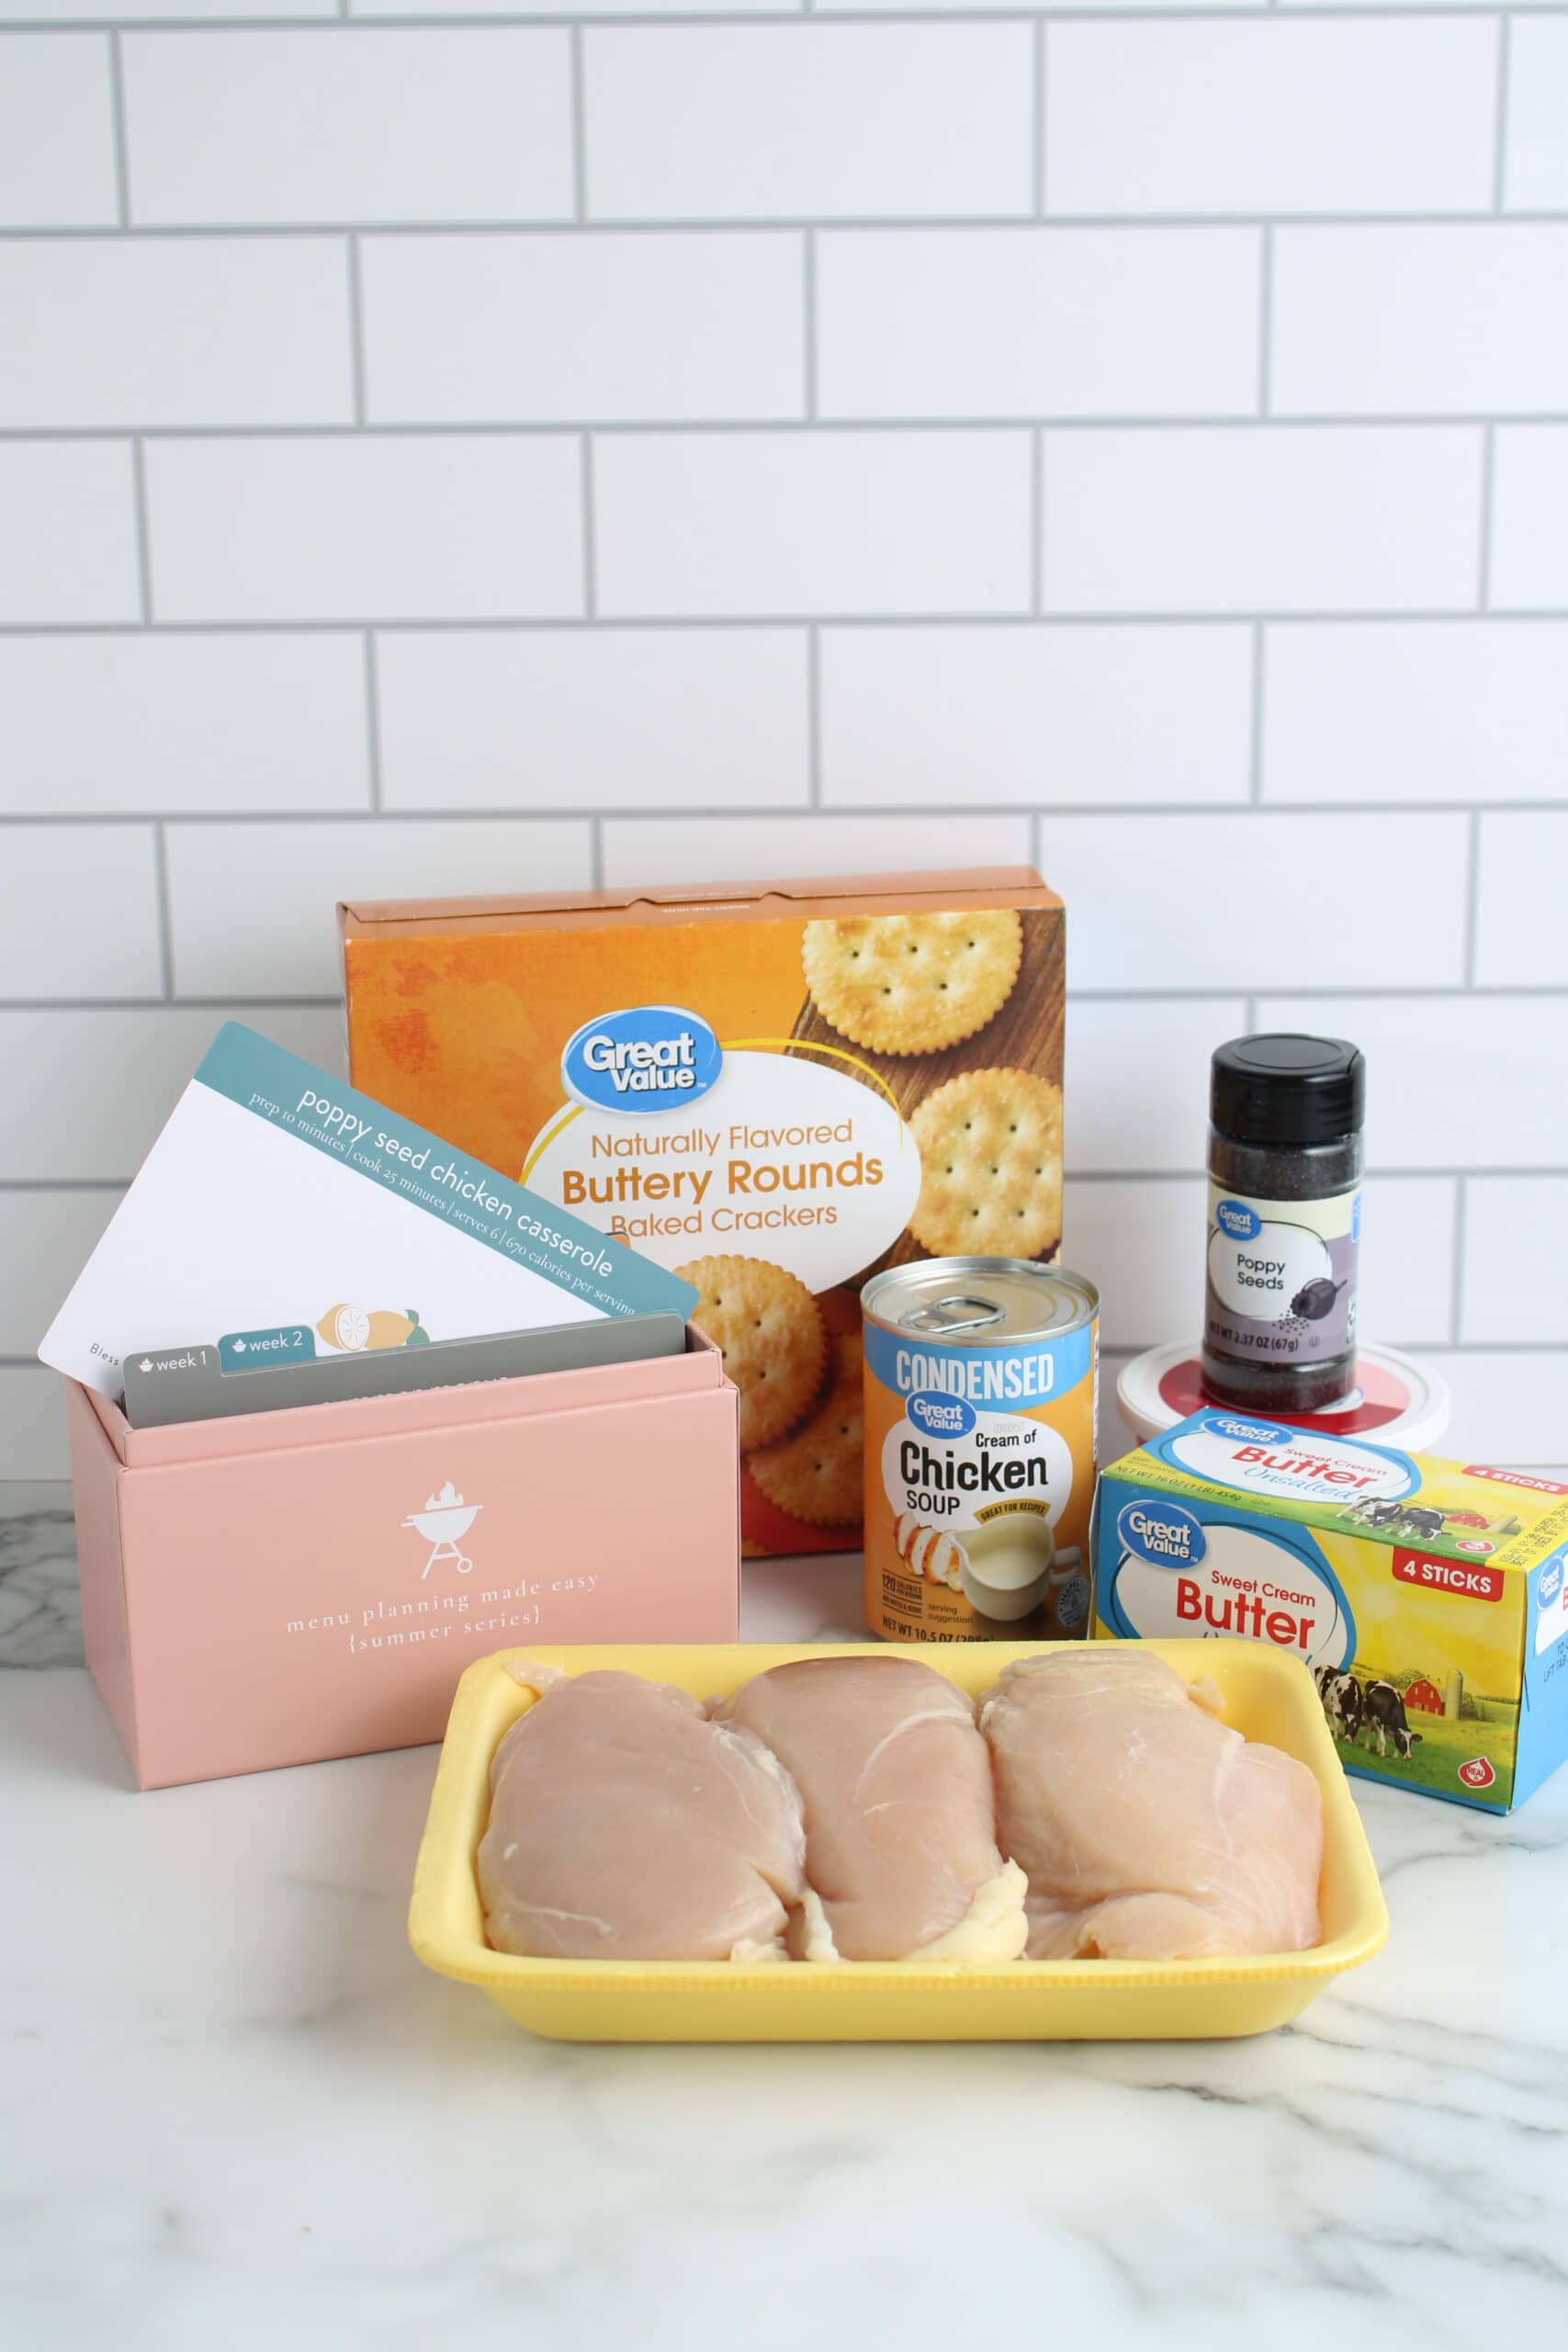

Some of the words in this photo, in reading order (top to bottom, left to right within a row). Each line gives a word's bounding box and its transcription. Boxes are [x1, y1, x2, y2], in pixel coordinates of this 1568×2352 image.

[582, 1032, 696, 1072] Great
[611, 1066, 696, 1093] Value
[591, 1128, 720, 1159] Naturally
[729, 1119, 852, 1150] Flavored
[296, 1090, 373, 1143] poppy
[375, 1132, 431, 1170] seed
[430, 1162, 513, 1221] chicken
[517, 1214, 613, 1278] casserole
[562, 1166, 713, 1205] Buttery
[728, 1152, 884, 1194] Rounds
[249, 1092, 280, 1117] prep
[281, 1111, 296, 1124] 10
[297, 1119, 346, 1152] minutes
[353, 1151, 383, 1174] cook
[383, 1169, 398, 1184] 25
[399, 1176, 446, 1211] minutes
[453, 1207, 490, 1236] serves
[490, 1227, 501, 1240] 6
[506, 1237, 527, 1255] 670
[528, 1250, 573, 1282] calories
[570, 1275, 594, 1293] per
[611, 1211, 702, 1238] Baked
[711, 1204, 838, 1232] Crackers
[1220, 1205, 1252, 1227] Great
[1225, 1219, 1252, 1235] Value
[1237, 1254, 1286, 1274] Poppy
[1237, 1272, 1285, 1290] Seeds
[89, 1342, 119, 1367] Bless
[249, 1332, 289, 1352] week
[293, 1331, 303, 1347] 2
[1234, 1331, 1255, 1346] 2.37
[1256, 1336, 1269, 1349] OZ
[1271, 1338, 1299, 1352] (67g)
[156, 1351, 197, 1372] week
[198, 1351, 208, 1365] 1
[897, 1350, 1055, 1400] CONDENSED
[913, 1398, 964, 1420] Great
[925, 1416, 963, 1430] Value
[1216, 1419, 1280, 1437] Great
[1225, 1427, 1272, 1442] Value
[976, 1433, 1020, 1448] Cream
[1024, 1429, 1037, 1443] of
[900, 1440, 1049, 1492] Chicken
[1232, 1446, 1379, 1488] Butter
[1283, 1448, 1330, 1463] Sweet
[1334, 1459, 1388, 1476] Cream
[1244, 1466, 1362, 1499] Unsalted
[1473, 1469, 1490, 1477] 4
[1491, 1472, 1561, 1493] STICKS
[907, 1489, 961, 1515] SOUP
[1004, 1503, 1019, 1513] FOR
[1129, 1511, 1191, 1545] Great
[1143, 1533, 1190, 1560] Value
[1212, 1570, 1258, 1593] Sweet
[1262, 1582, 1316, 1608] Cream
[1404, 1560, 1416, 1577] 4
[1422, 1564, 1492, 1593] STICKS
[287, 1612, 350, 1634] menu
[363, 1594, 469, 1627] planning
[480, 1580, 540, 1604] made
[552, 1574, 599, 1592] easy
[928, 1603, 958, 1615] serving
[1177, 1577, 1316, 1649] Butter
[349, 1623, 453, 1654] {summer
[464, 1605, 542, 1634] series}
[883, 1615, 897, 1631] NET
[898, 1623, 912, 1637] WT
